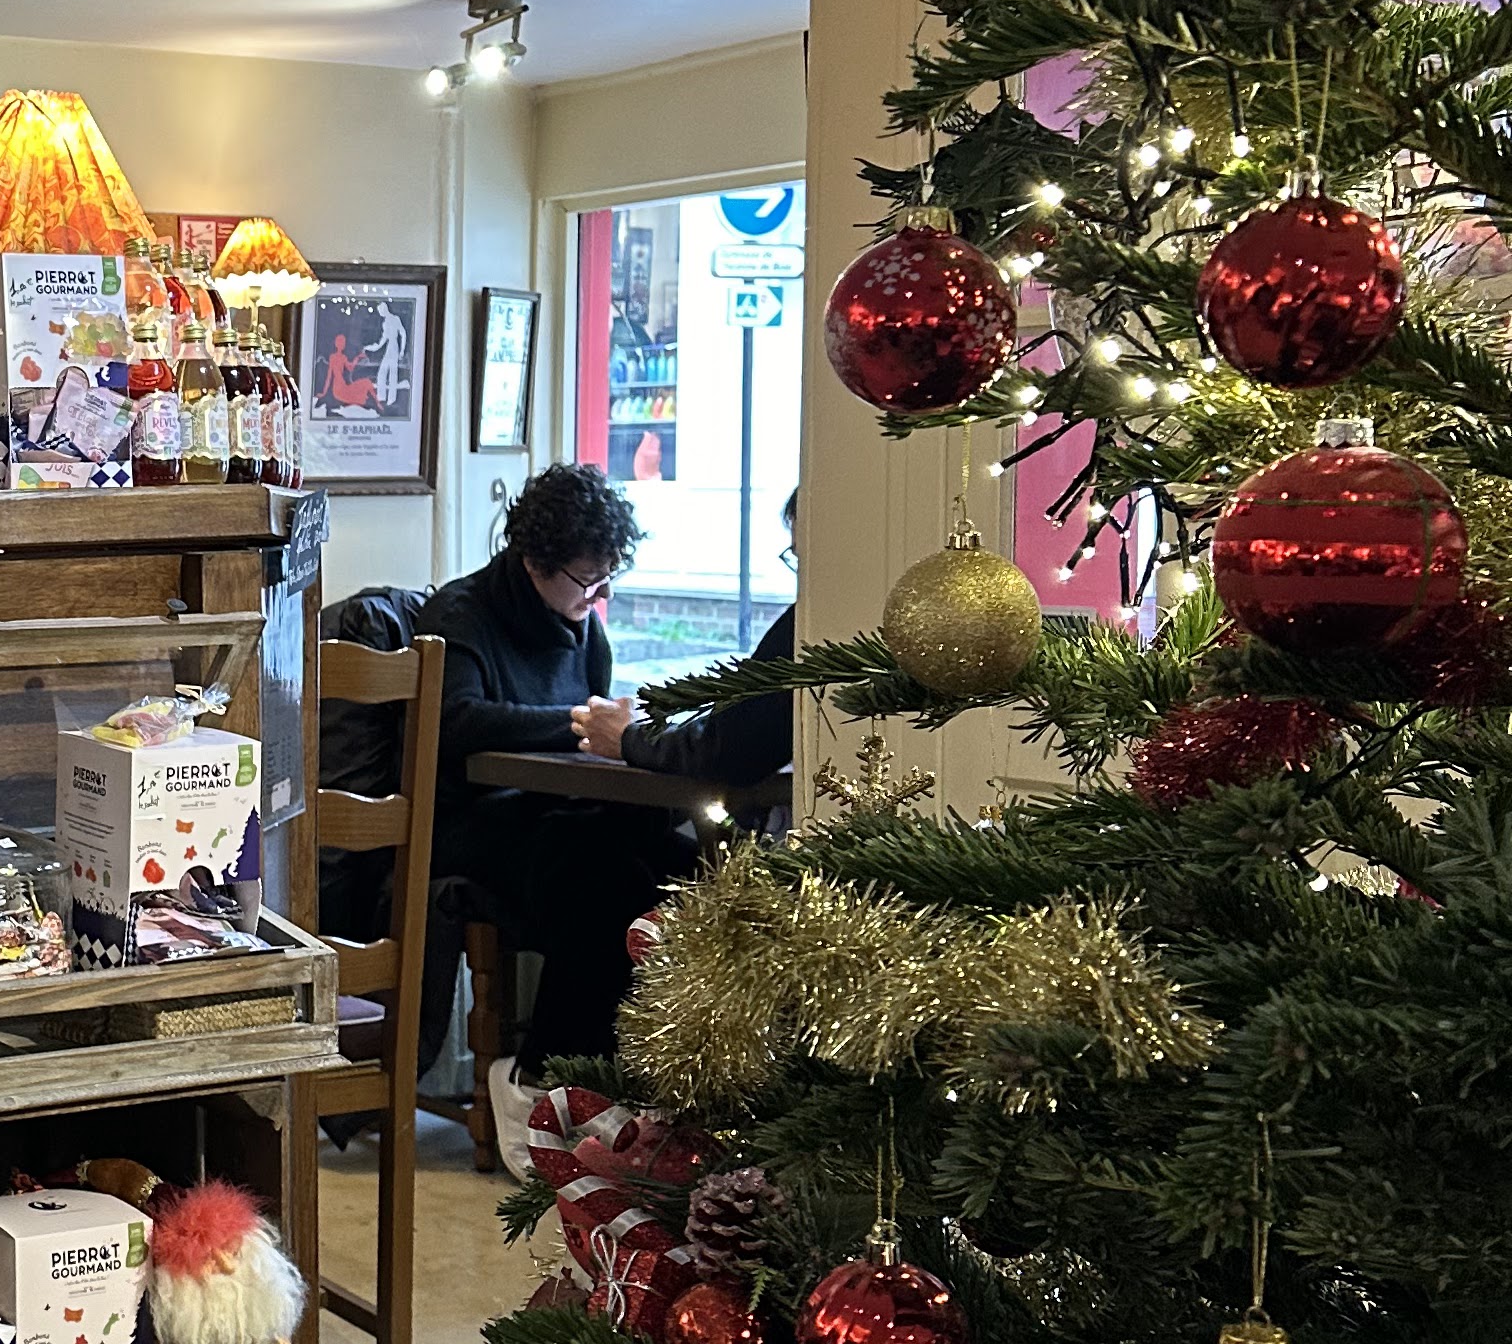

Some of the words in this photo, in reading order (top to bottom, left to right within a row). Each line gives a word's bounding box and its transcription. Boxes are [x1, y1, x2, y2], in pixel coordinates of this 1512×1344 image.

[35, 270, 96, 285] PIERROT
[36, 284, 98, 296] GOURMAND
[73, 765, 108, 787] PIERROT
[166, 762, 231, 781] PIERROT
[72, 779, 107, 797] GOURMAND
[165, 778, 232, 793] GOURMAND
[51, 1243, 120, 1268] PIERROT
[51, 1258, 122, 1281] GOURMAND
